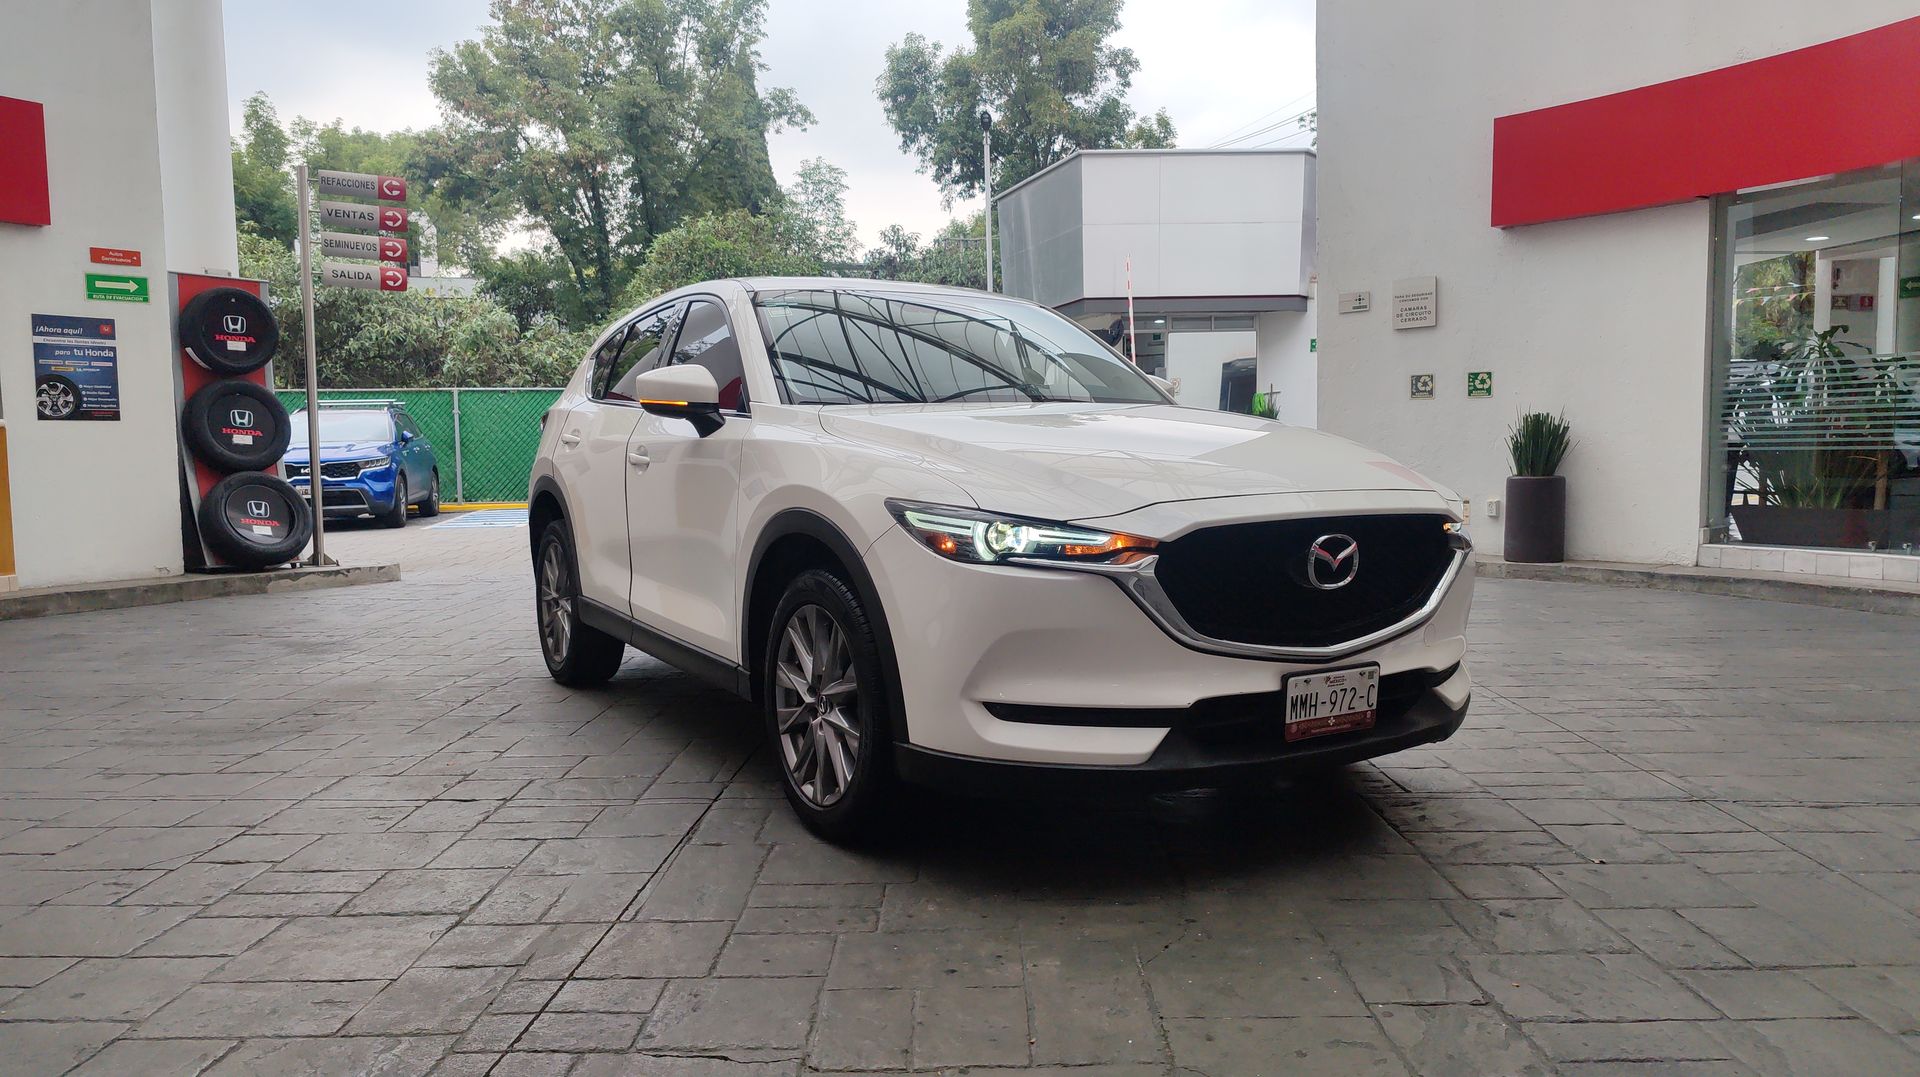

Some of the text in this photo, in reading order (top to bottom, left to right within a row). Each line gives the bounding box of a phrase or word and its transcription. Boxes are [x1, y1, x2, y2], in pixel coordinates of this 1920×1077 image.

[321, 176, 376, 191] REFACCIONES
[326, 208, 375, 221] VENTAS
[323, 238, 378, 252] SEMINUEVOS
[331, 269, 373, 281] SALIDA
[214, 334, 257, 343] HONDA
[73, 348, 83, 356] tu
[85, 348, 114, 357] Honda
[221, 427, 264, 437] HONDA
[240, 518, 281, 527] HONDA
[1290, 683, 1376, 721] MMH-972-C
